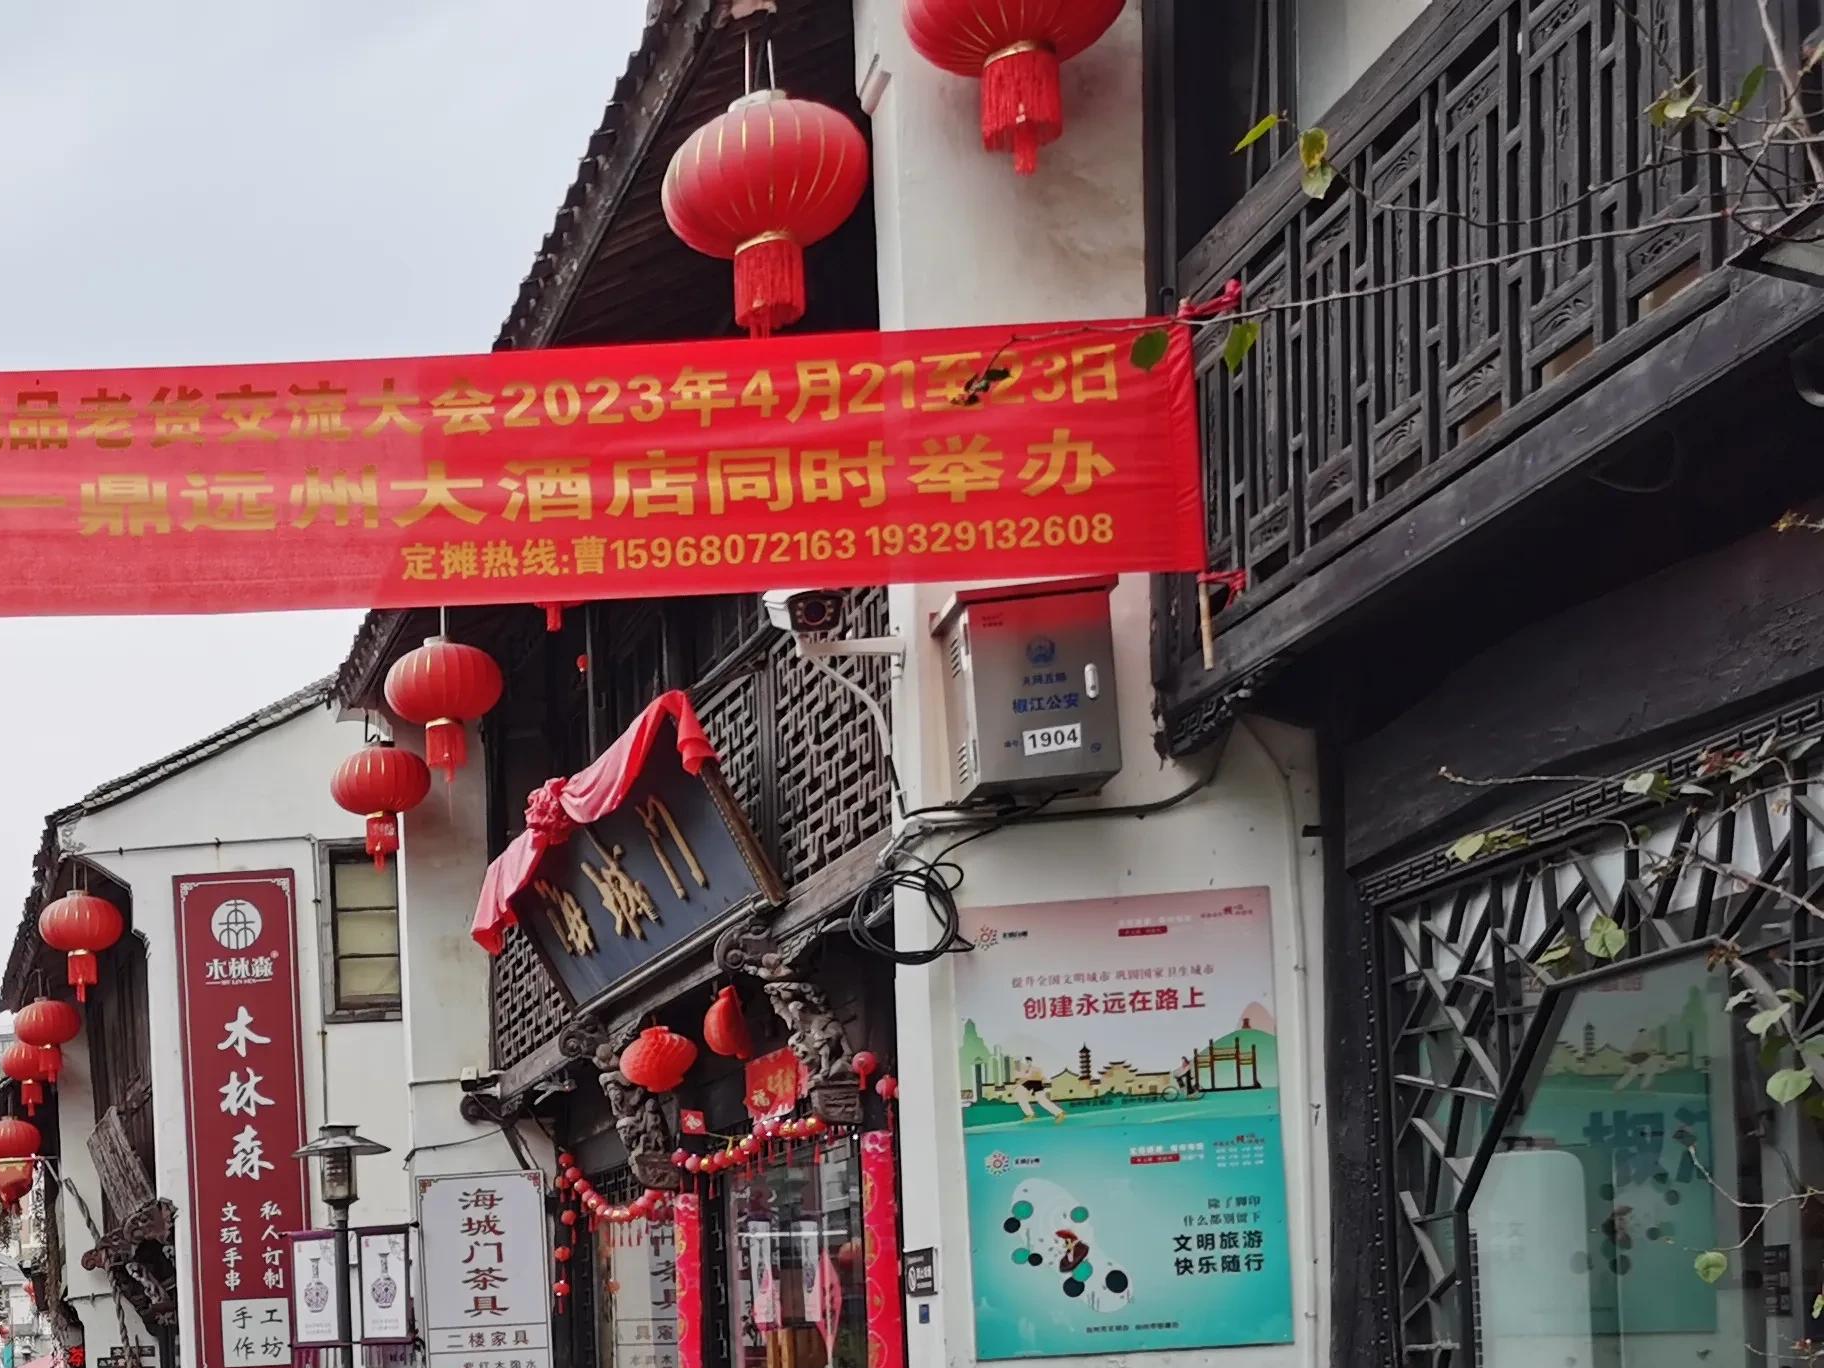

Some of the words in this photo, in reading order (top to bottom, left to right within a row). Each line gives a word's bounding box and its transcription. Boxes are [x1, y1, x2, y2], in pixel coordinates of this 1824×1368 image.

[866, 514, 1115, 557] 19329132608
[1028, 729, 1078, 749] 1904
[1023, 987, 1206, 1020] 创建永远在路上
[216, 1005, 276, 1181] 木林森
[1207, 1195, 1261, 1210] 除了脚印
[1183, 1212, 1261, 1227] 什么都别留下
[219, 1201, 243, 1292] 文玩手串
[259, 1200, 284, 1290] 私人订制
[458, 1188, 508, 1317] 海城门茶具
[1173, 1230, 1263, 1252] 文明旅游
[1174, 1254, 1264, 1276] 快乐随行
[447, 1331, 530, 1349] 二楼家具
